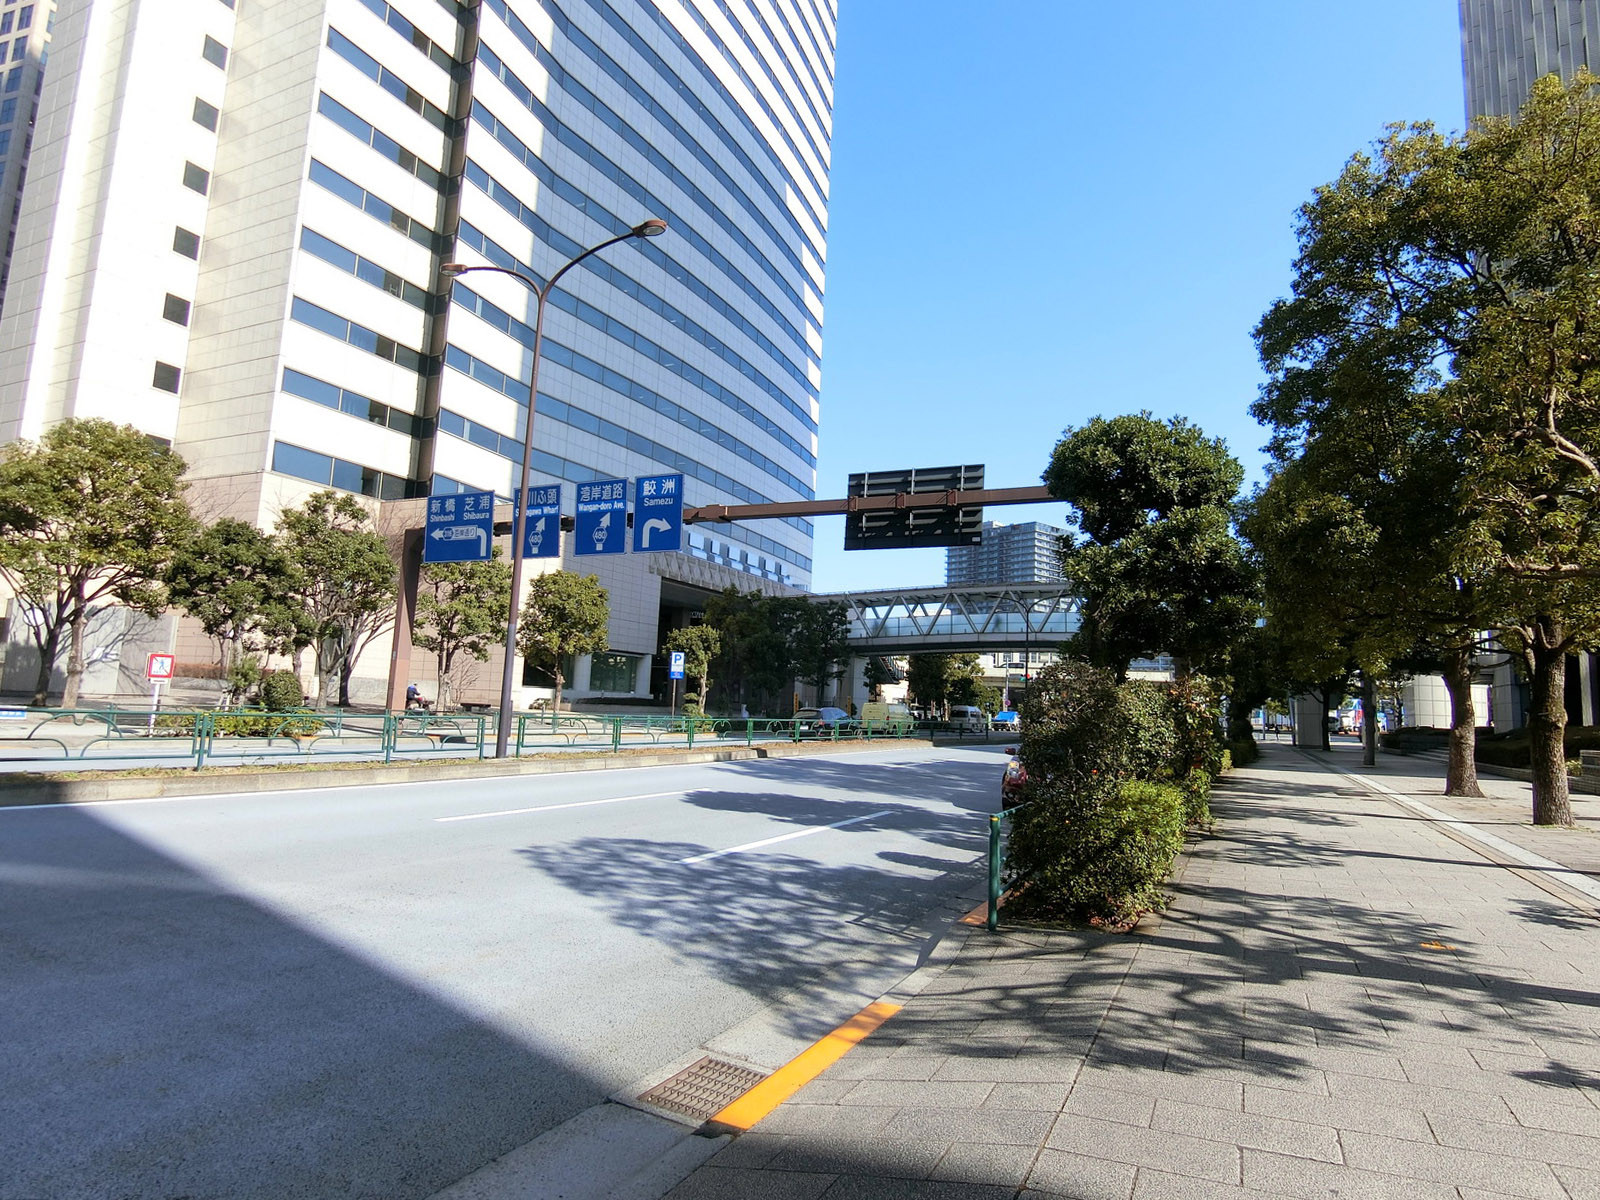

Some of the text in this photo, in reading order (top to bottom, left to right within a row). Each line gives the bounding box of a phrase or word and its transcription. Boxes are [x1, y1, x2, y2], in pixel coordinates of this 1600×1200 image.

[643, 478, 675, 496] 鮫洲
[580, 483, 623, 502] 湾岸道路
[518, 489, 557, 507] 川ふ頭
[643, 498, 674, 507] Samezu
[430, 495, 491, 513] 新橋 芝浦
[578, 501, 625, 512] Wangan-doro Ave.
[543, 505, 559, 514] Wharf
[430, 512, 490, 522] Shinbashi Shibaura
[530, 535, 542, 543] 480
[594, 531, 606, 540] 480
[674, 654, 682, 664] P
